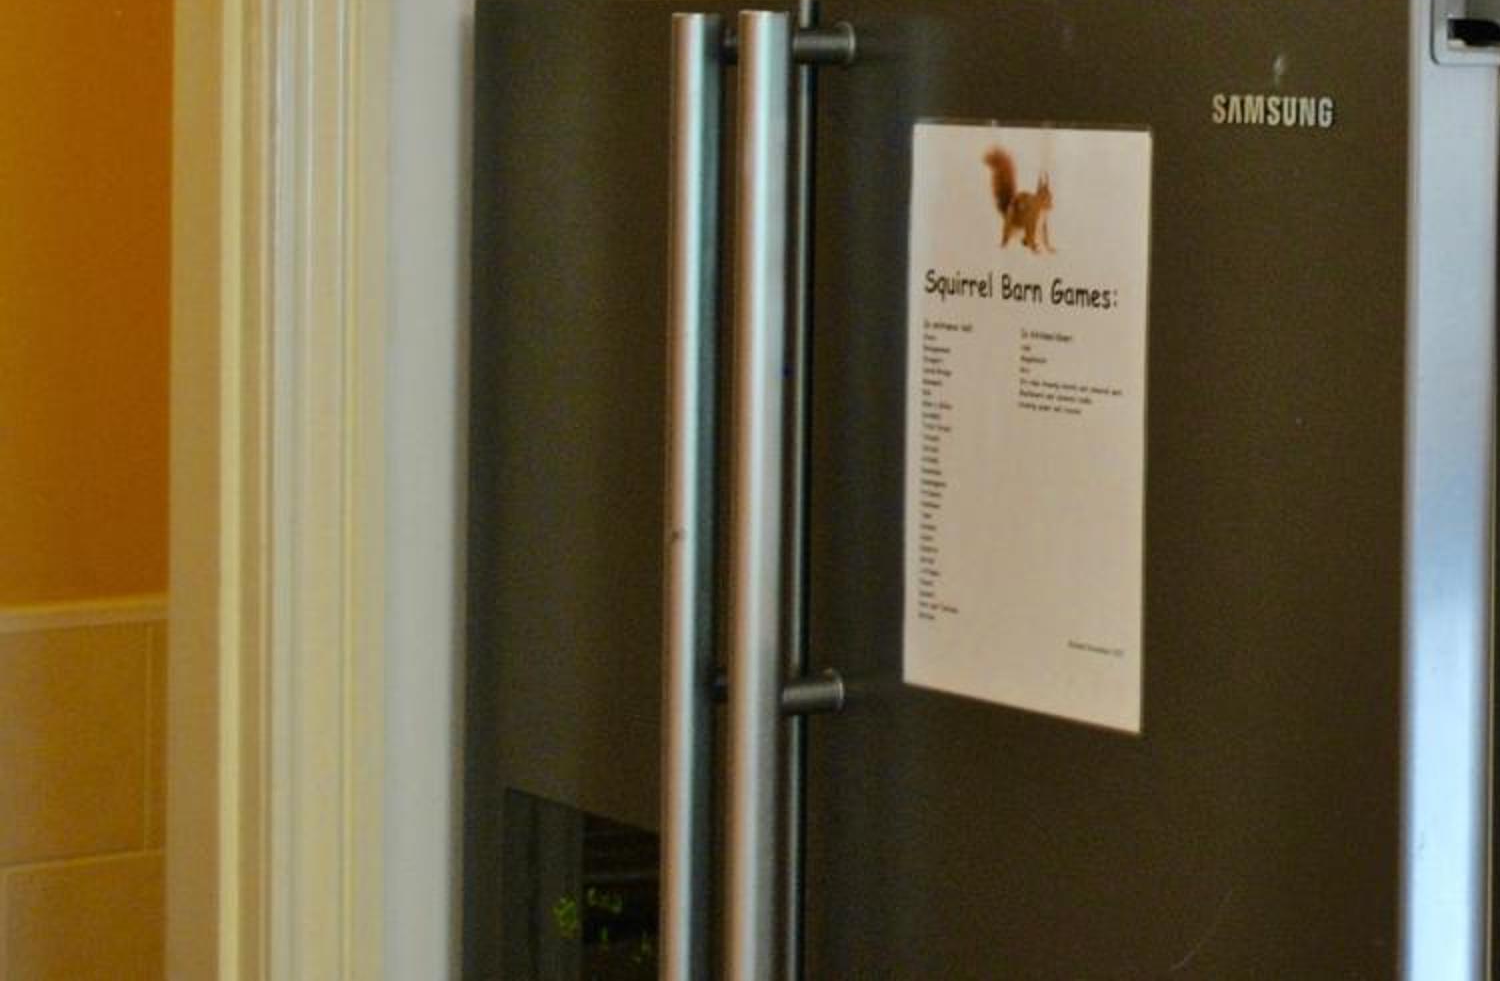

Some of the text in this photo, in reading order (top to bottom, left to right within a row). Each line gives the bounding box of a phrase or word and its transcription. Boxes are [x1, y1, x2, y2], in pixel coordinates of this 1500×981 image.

[1212, 93, 1334, 128] SAMSUNG
[925, 269, 1118, 310] Squirrel Barn Games:
